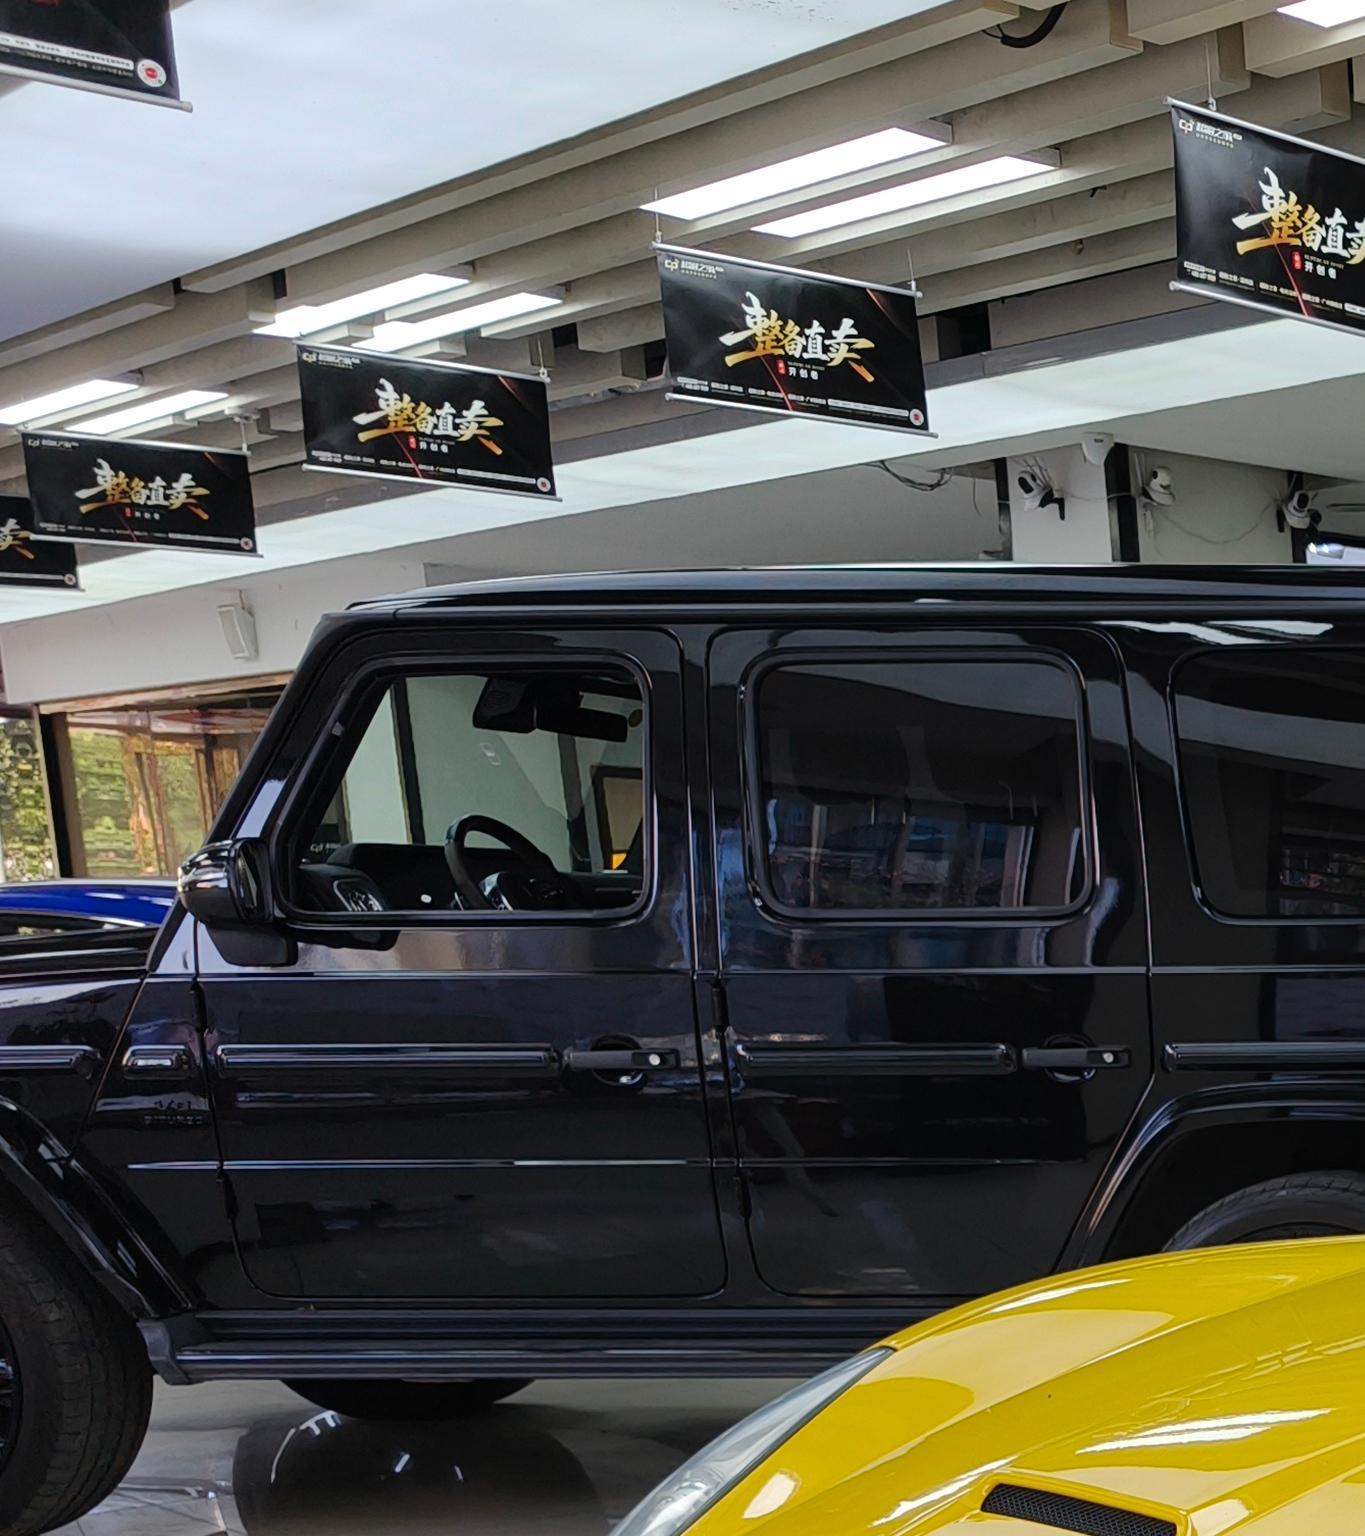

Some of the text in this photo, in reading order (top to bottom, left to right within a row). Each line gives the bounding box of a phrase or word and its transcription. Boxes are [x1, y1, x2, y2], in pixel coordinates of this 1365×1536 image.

[718, 291, 875, 383] 整备直卖
[352, 377, 504, 455] 整备直卖
[75, 457, 210, 520] 整备直卖
